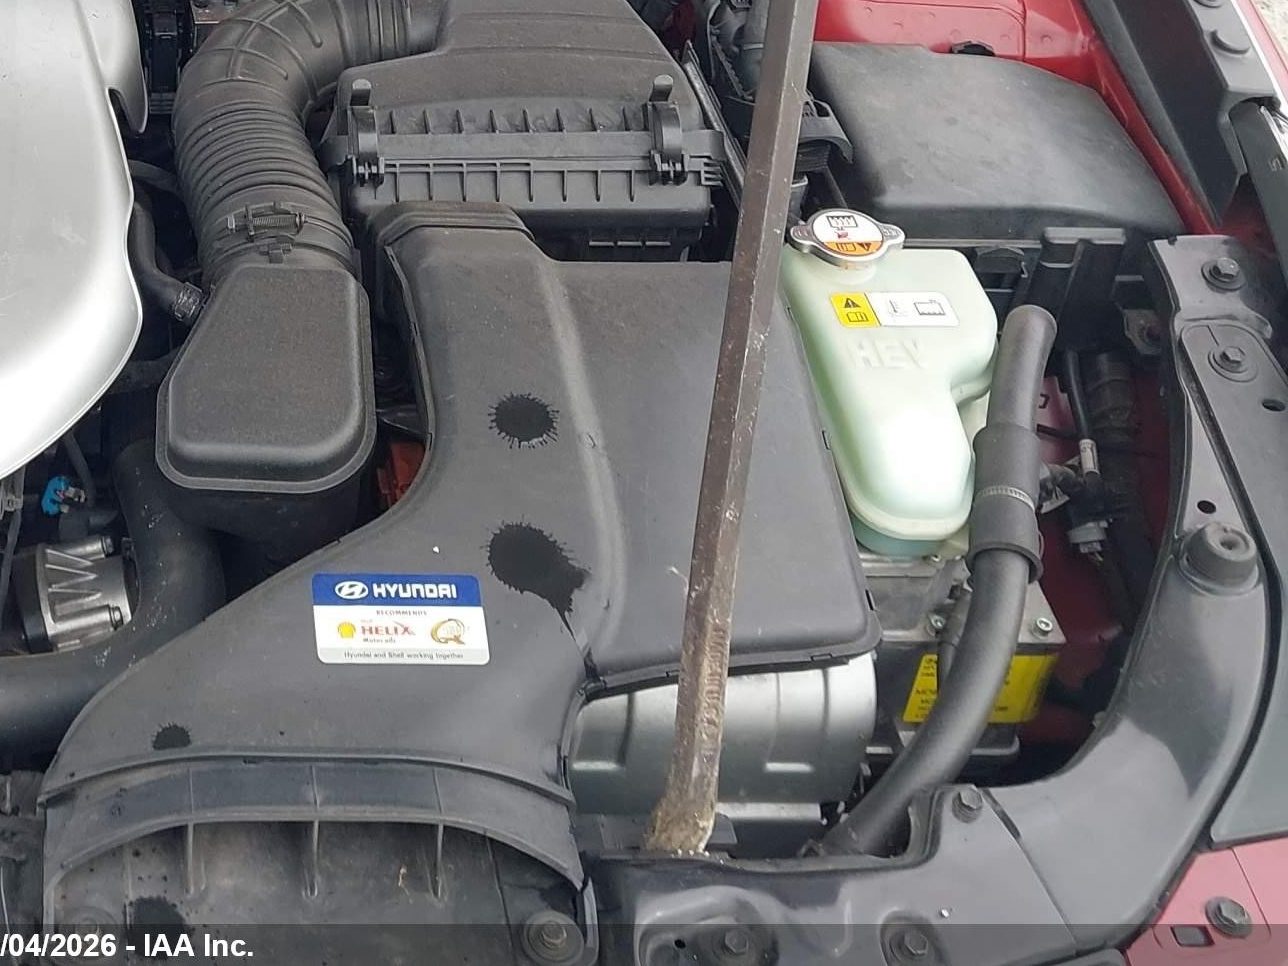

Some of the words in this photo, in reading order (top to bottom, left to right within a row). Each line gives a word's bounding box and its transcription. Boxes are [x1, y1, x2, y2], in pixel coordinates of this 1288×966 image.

[849, 339, 928, 370] HEV
[372, 583, 457, 598] HYUNDAI
[361, 622, 414, 636] HELIX
[344, 651, 372, 659] Hyundai
[373, 651, 387, 659] and
[407, 651, 434, 660] working
[435, 651, 464, 660] together
